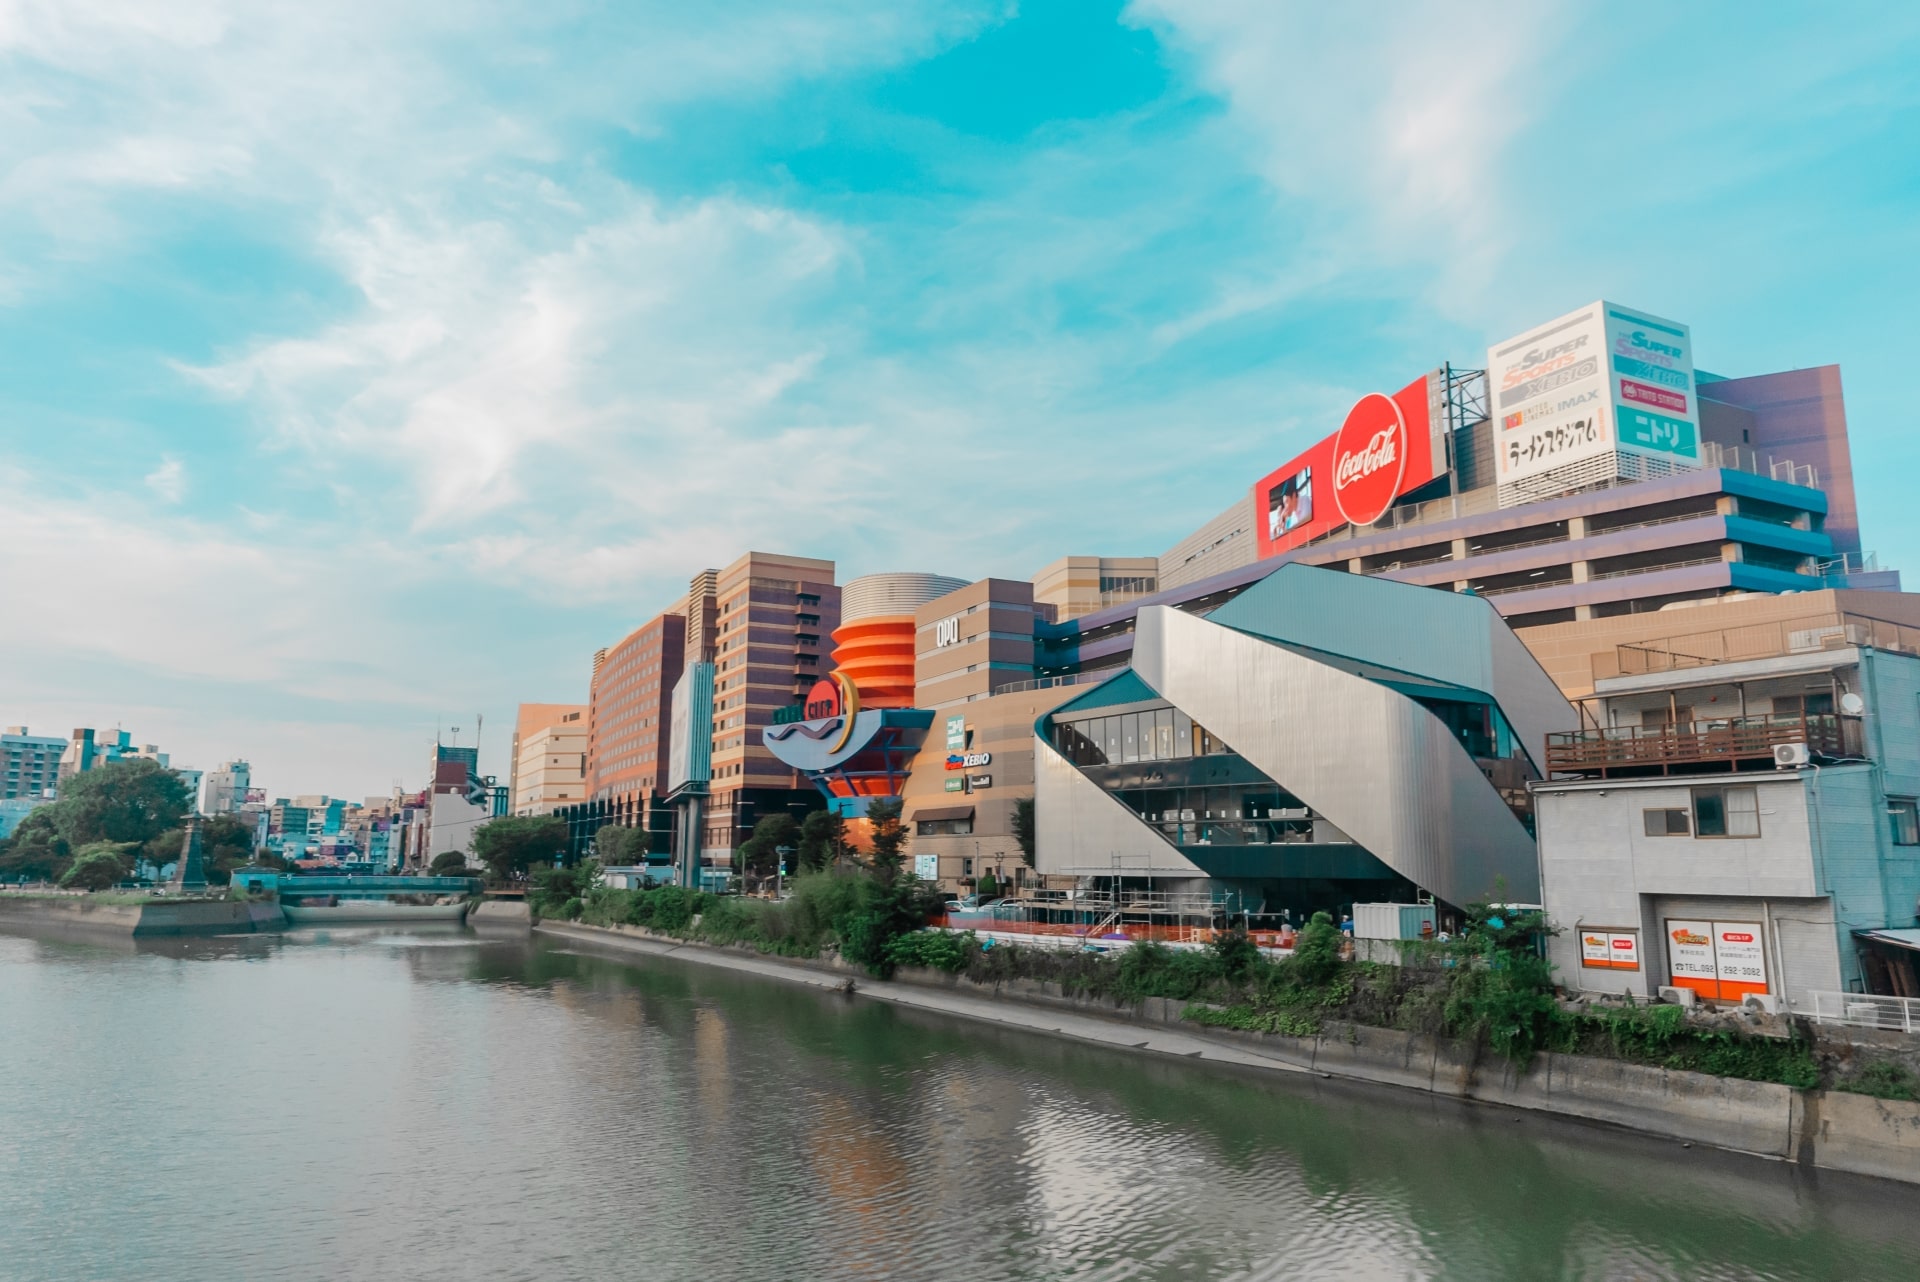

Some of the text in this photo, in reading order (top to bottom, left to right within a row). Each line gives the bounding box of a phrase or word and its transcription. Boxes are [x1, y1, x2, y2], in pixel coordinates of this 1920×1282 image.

[1520, 334, 1589, 370] SUPER
[1615, 338, 1673, 368] SPORTS
[1631, 331, 1682, 359] SUPER
[1501, 352, 1576, 390] SPORTS
[1524, 360, 1595, 399] XEBIO
[1557, 389, 1599, 412] IMAX
[1510, 417, 1597, 468] ラーメンスタジアム
[1635, 415, 1680, 448] ニトリ
[1336, 422, 1399, 491] Coca-Cola
[962, 753, 990, 768] XEBIO
